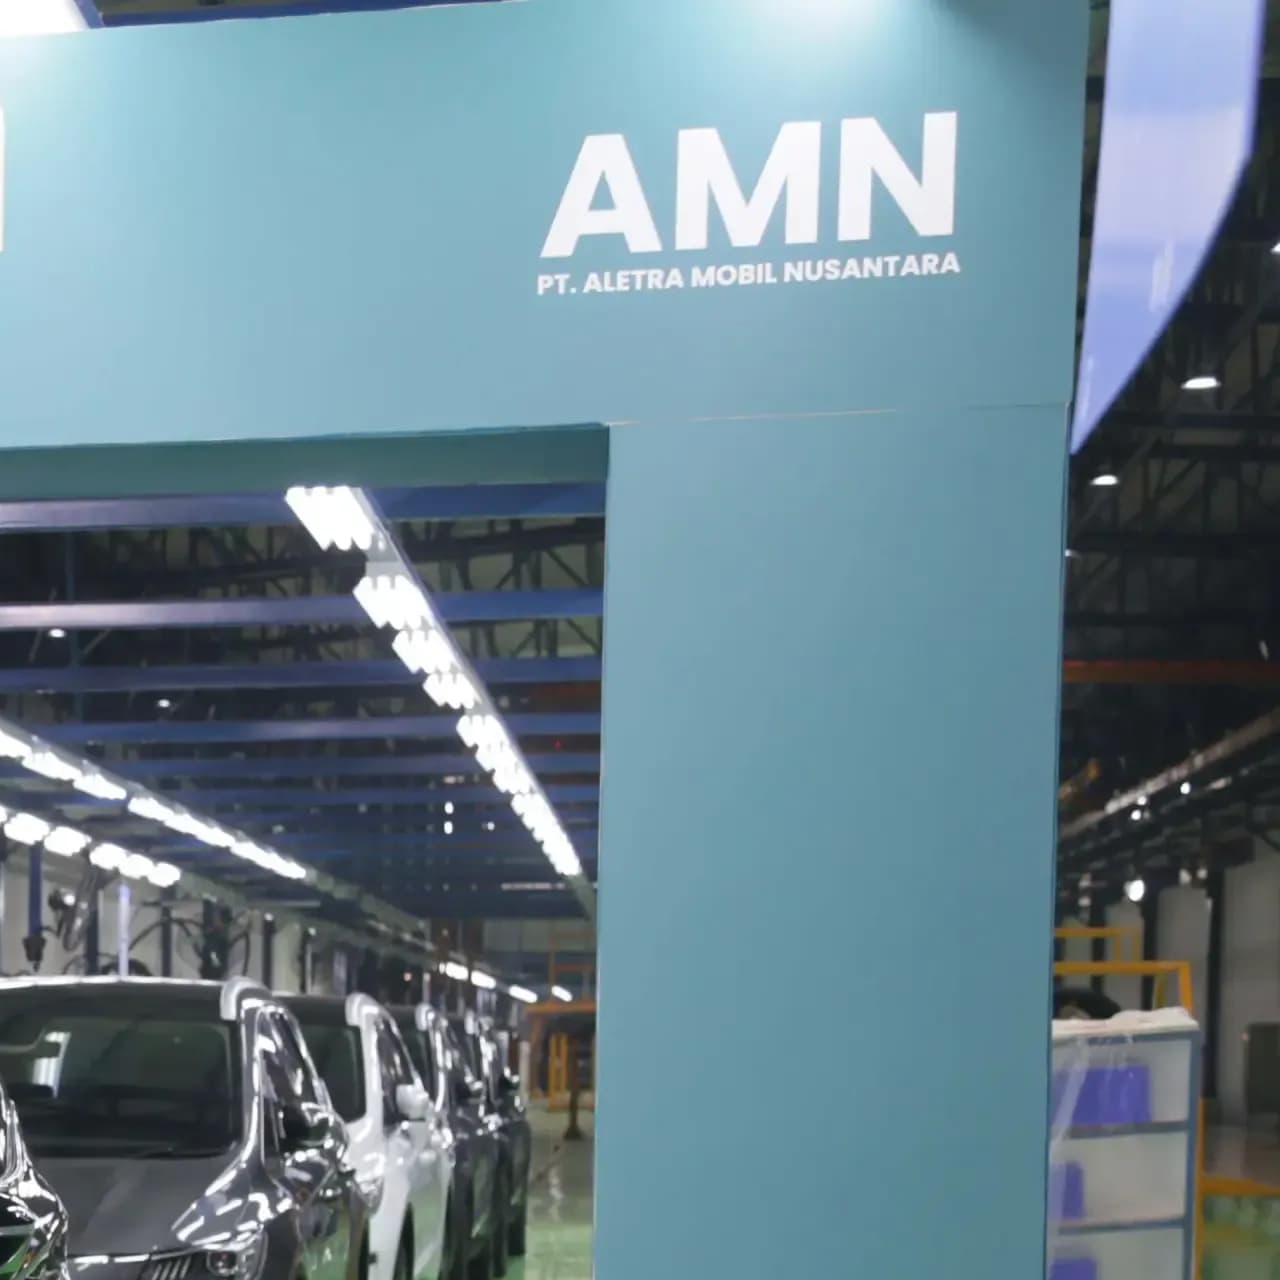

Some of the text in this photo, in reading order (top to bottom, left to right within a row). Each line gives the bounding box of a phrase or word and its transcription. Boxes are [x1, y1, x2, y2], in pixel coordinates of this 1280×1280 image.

[539, 111, 958, 257] AMN
[537, 252, 961, 296] PT. ALETRA MOBIL NUSANTARA
